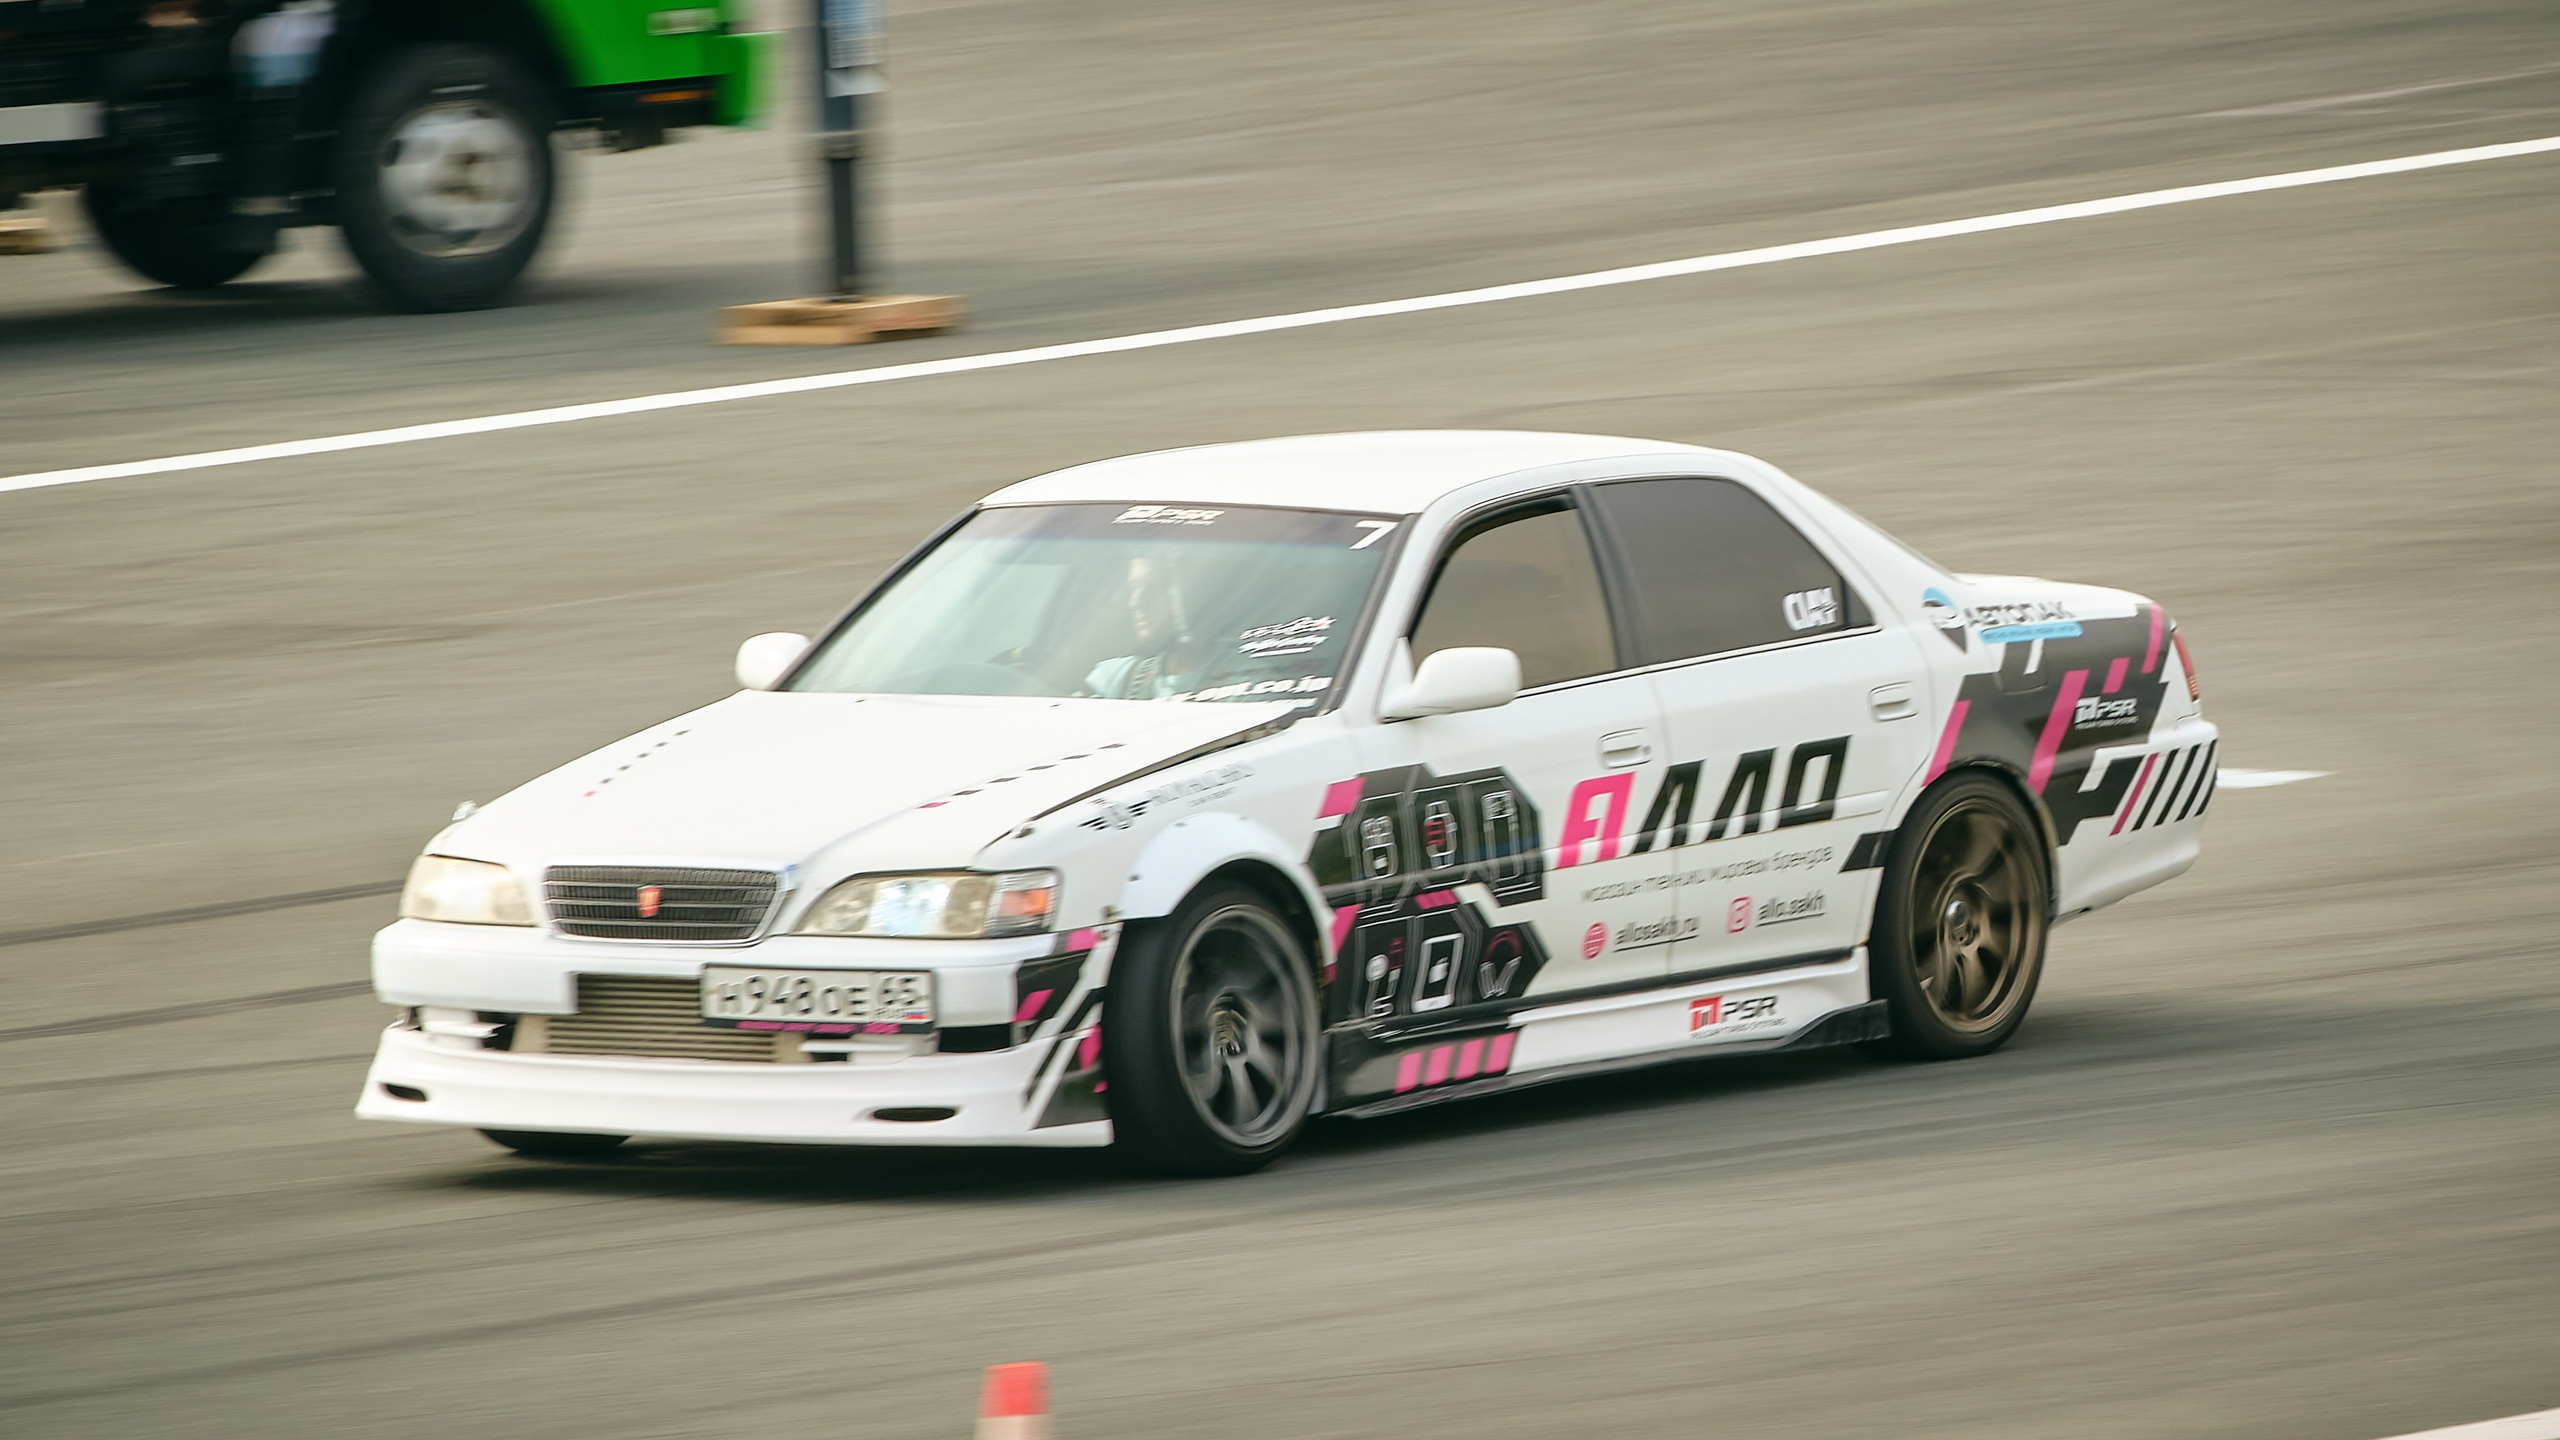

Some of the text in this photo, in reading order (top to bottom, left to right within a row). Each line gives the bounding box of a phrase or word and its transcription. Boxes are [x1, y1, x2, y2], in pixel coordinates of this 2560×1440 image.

[1349, 520, 1399, 549] 7
[2096, 698, 2138, 719] PSR
[1722, 995, 1778, 1022] PSR
